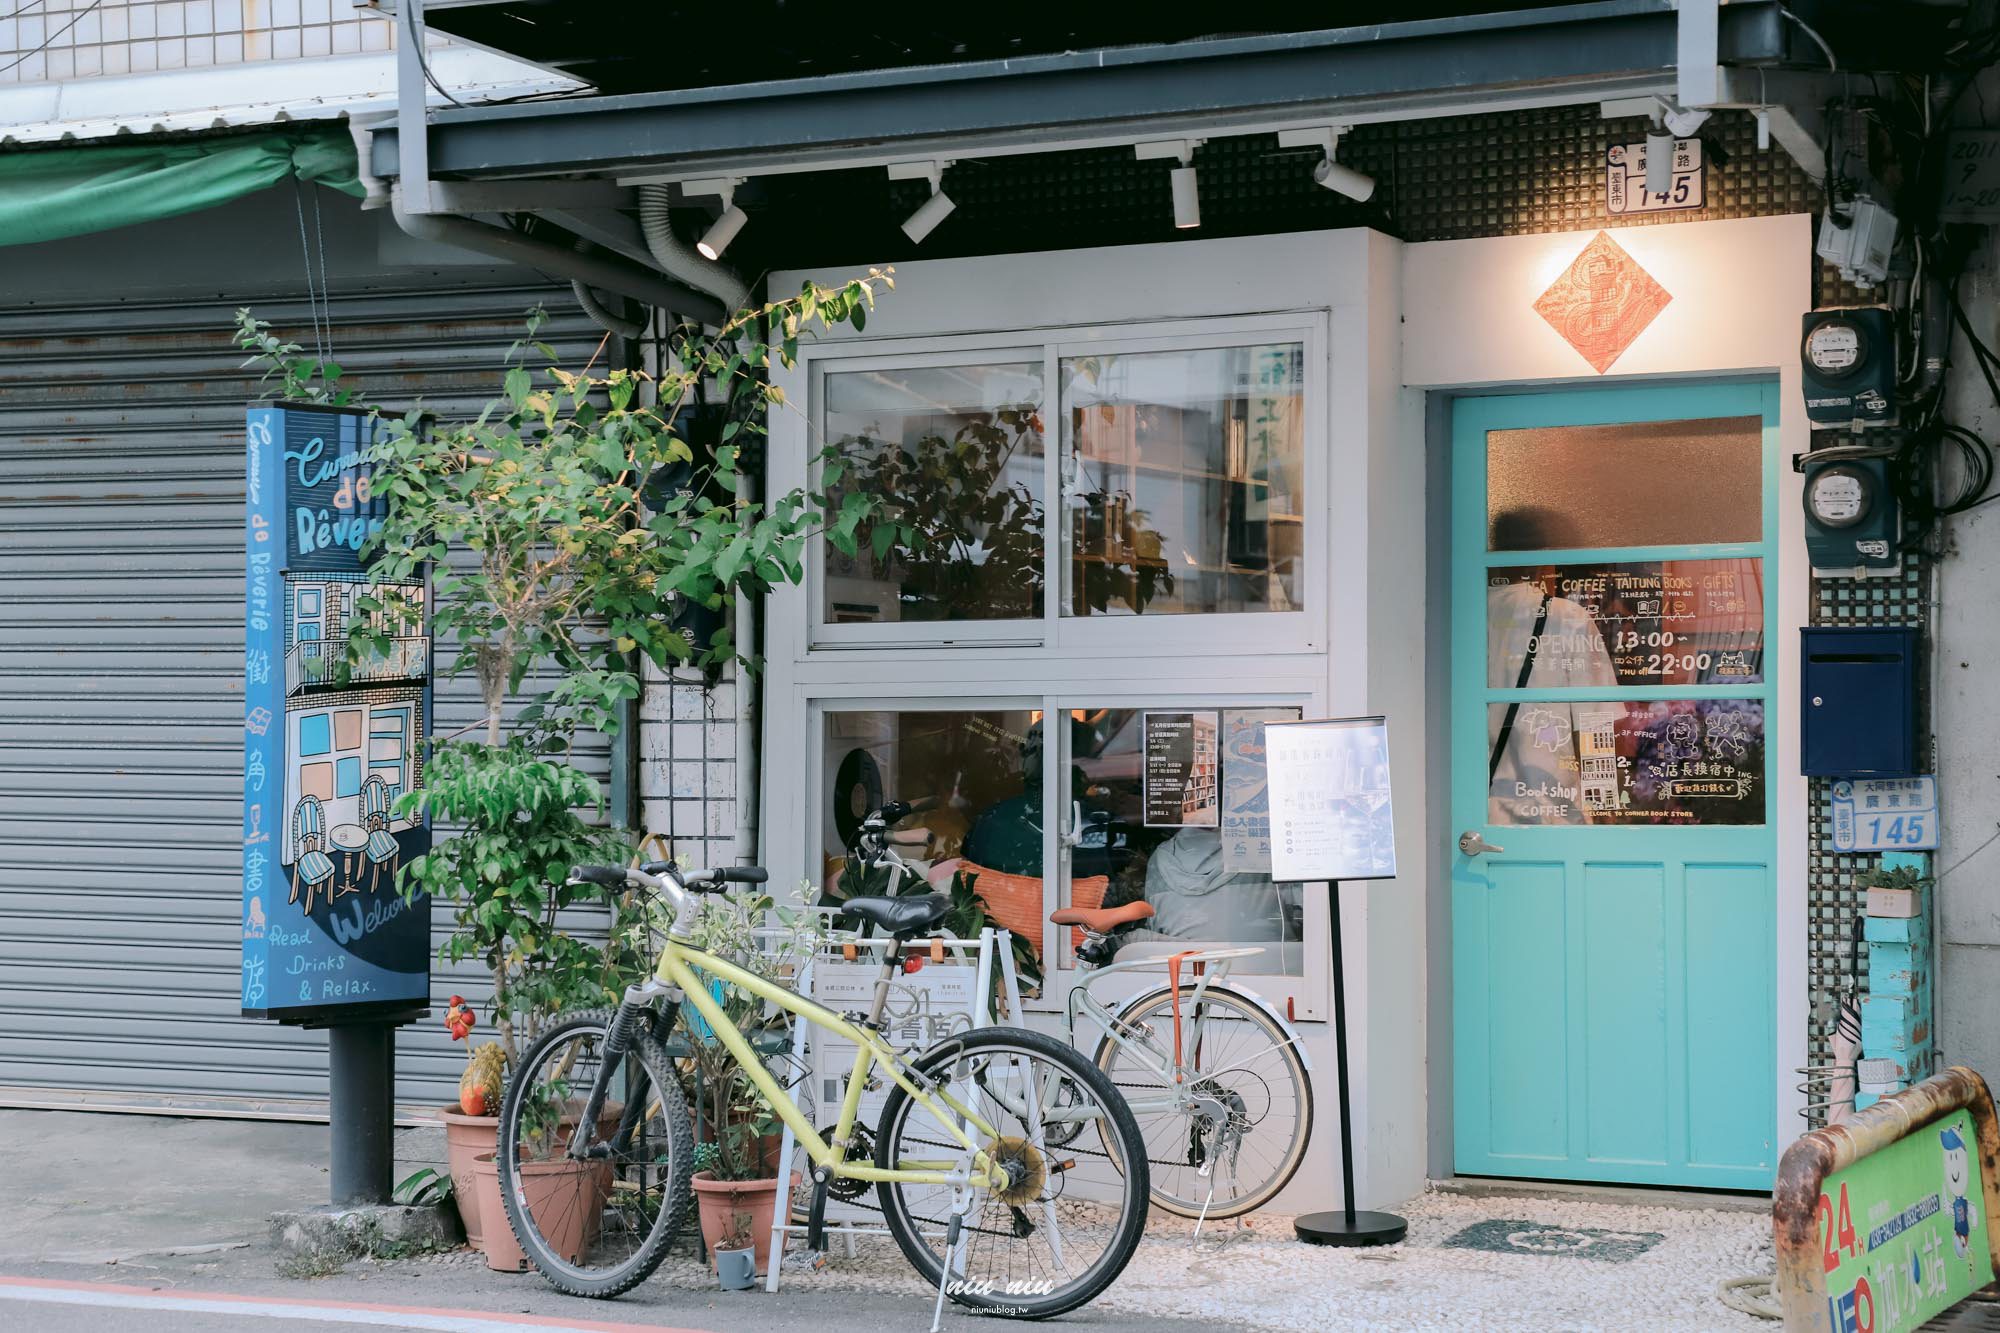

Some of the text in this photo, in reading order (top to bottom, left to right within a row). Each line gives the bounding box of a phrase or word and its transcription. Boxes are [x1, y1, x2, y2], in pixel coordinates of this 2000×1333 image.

[1638, 154, 1690, 171] 廣路
[333, 477, 372, 509] de
[251, 513, 269, 542] de
[296, 507, 411, 555] Rêver
[250, 552, 271, 631] Rêverie
[1562, 578, 1606, 592] COFFEE
[1615, 577, 1661, 589] TAITUNG
[1663, 577, 1692, 589] BOOKS
[1703, 575, 1735, 589] GIFTS
[1527, 634, 1605, 653] OPENING
[1647, 653, 1711, 675] 22:00
[1634, 730, 1657, 739] OFFICE
[1521, 804, 1568, 817] COFFEE
[1869, 816, 1924, 845] 145
[269, 924, 312, 946] Read
[287, 955, 345, 975] Drinks
[300, 980, 312, 1000] &
